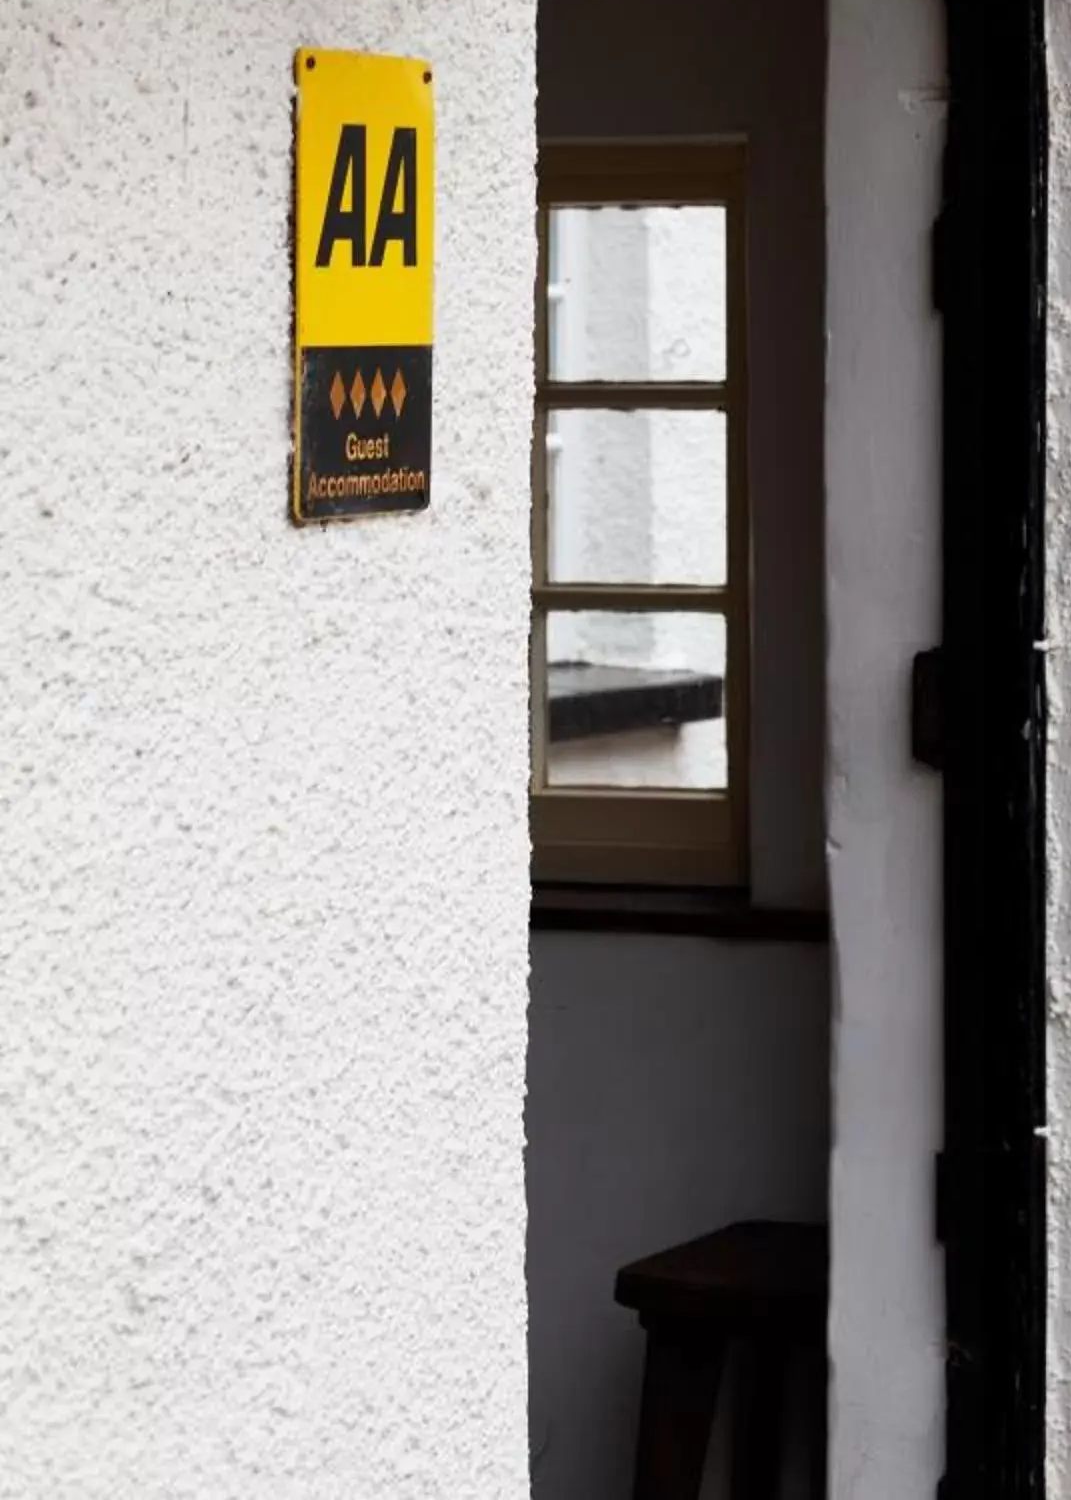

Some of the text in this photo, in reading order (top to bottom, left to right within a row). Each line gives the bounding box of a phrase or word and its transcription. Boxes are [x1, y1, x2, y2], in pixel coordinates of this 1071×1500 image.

[315, 123, 418, 268] AA
[345, 431, 390, 461] Guest
[308, 466, 425, 500] Accommodation
